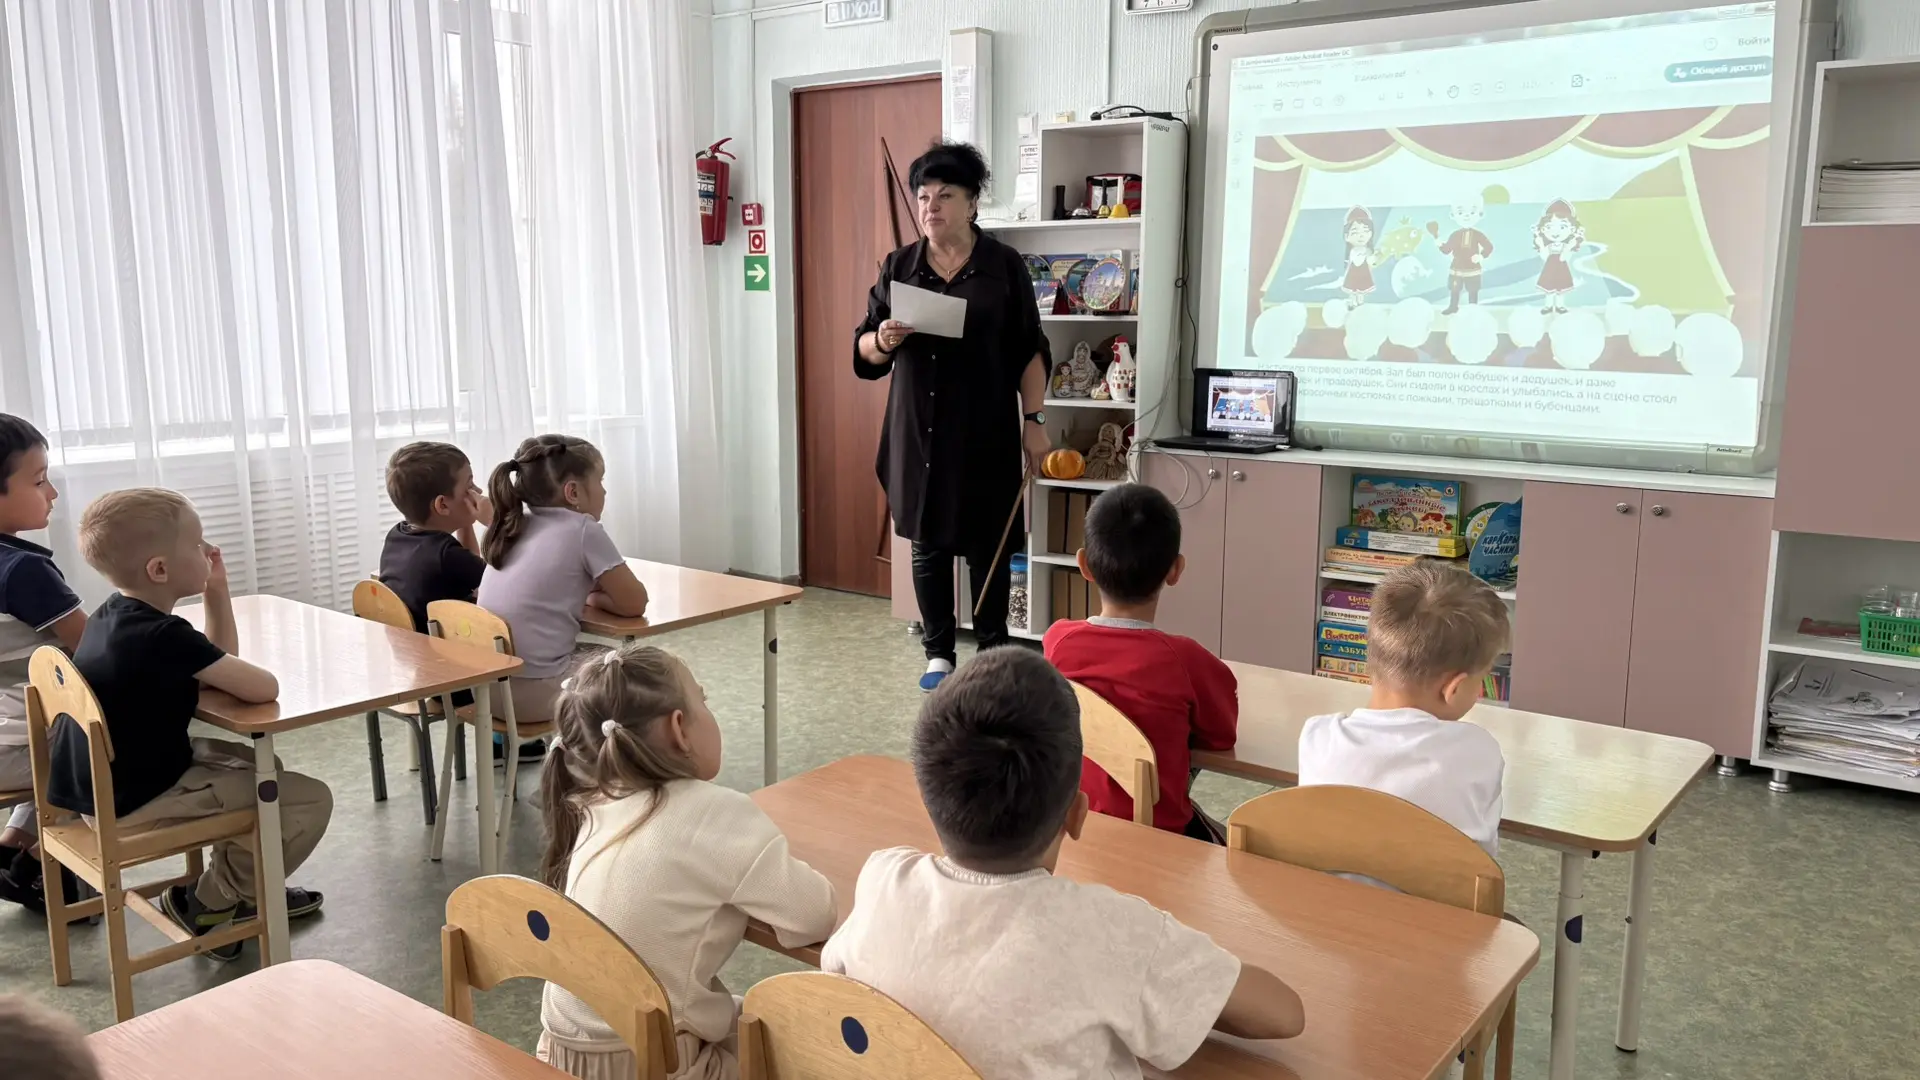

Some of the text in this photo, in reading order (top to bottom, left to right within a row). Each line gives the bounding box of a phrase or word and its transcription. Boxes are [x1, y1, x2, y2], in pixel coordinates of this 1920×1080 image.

[1737, 37, 1771, 47] Войти
[1690, 64, 1728, 76] Общий
[1306, 364, 1342, 375] первое
[1386, 368, 1404, 377] Зал
[1406, 368, 1426, 378] был
[1428, 371, 1461, 379] полон
[1462, 371, 1509, 382] бабушек
[1575, 378, 1584, 386] и
[1586, 379, 1617, 388] даже
[1386, 379, 1407, 388] Они
[1409, 382, 1447, 392] сидели
[1457, 385, 1500, 395] креслах
[1586, 391, 1601, 400] на
[1603, 393, 1640, 403] сцене
[1642, 395, 1678, 404] стоял
[1350, 391, 1397, 400] костюмах
[1457, 397, 1522, 408] трещотками
[1534, 400, 1601, 414] бубенцами.
[1323, 610, 1369, 620] ЭЛЕКТРОВИКТОР
[1325, 629, 1369, 642] Викторин
[1339, 646, 1368, 656] АЗБУК
